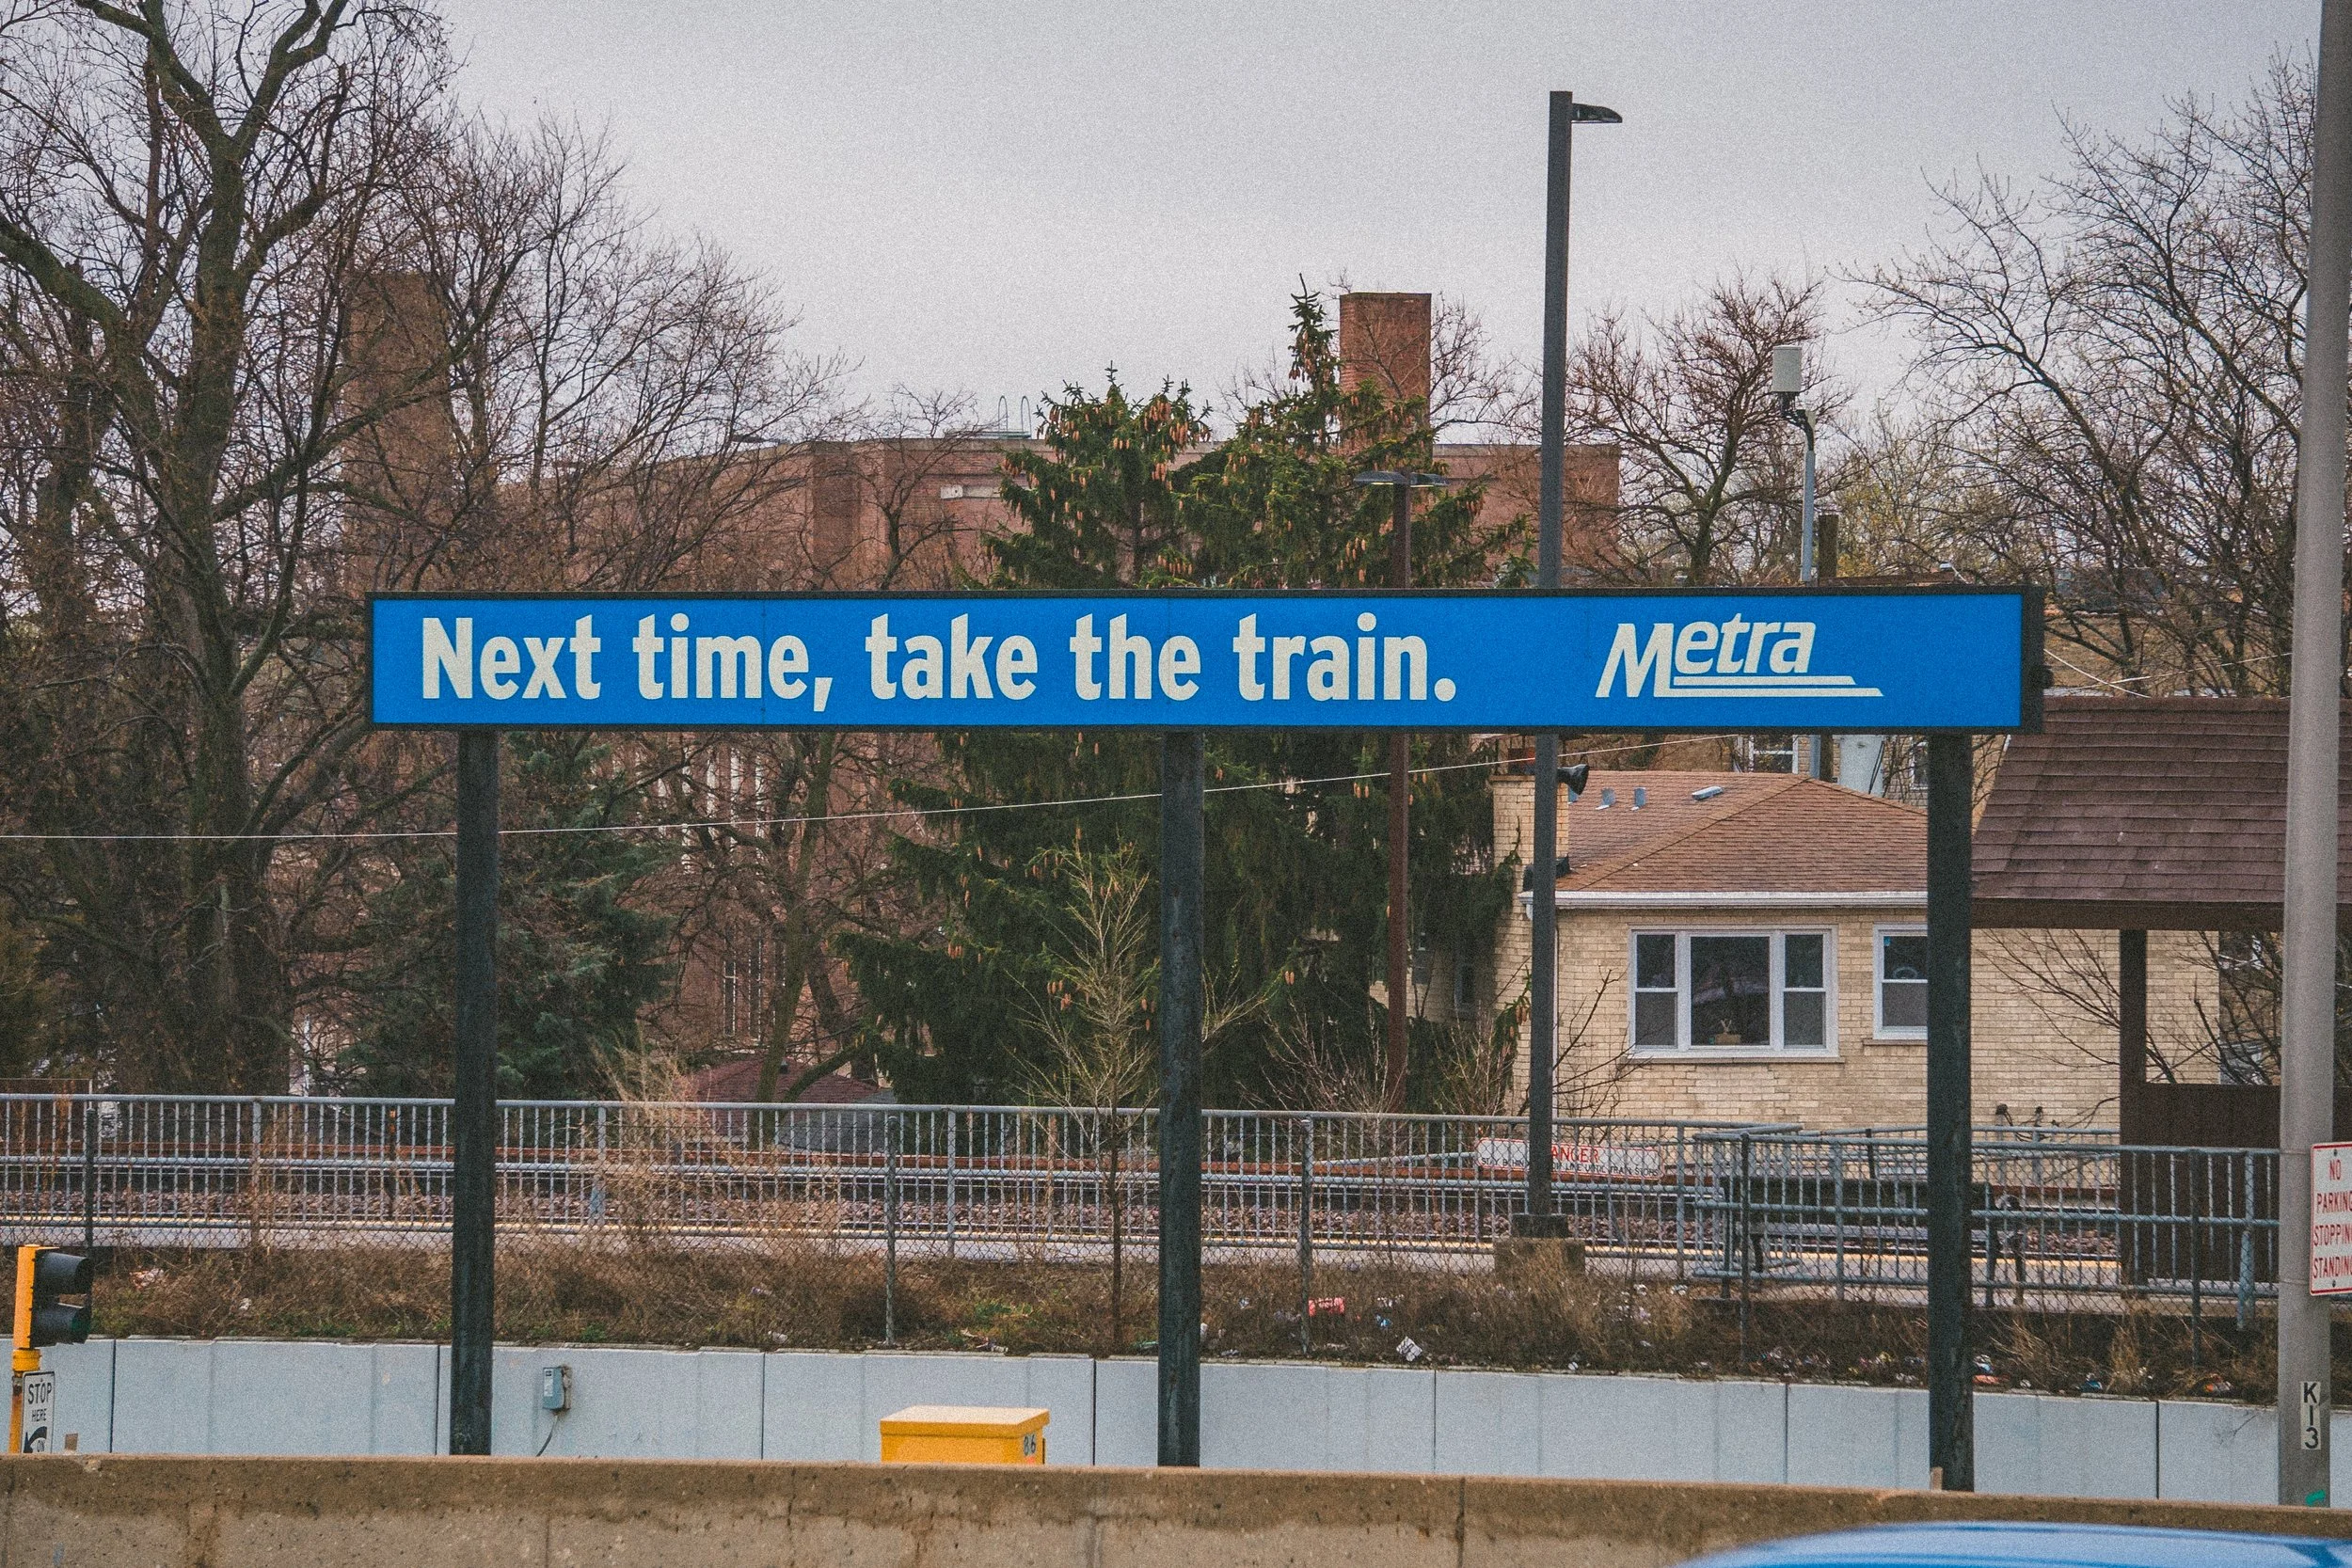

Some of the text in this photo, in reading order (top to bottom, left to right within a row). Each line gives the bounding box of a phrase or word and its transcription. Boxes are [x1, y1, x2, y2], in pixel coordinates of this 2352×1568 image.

[422, 612, 1456, 712] Next time, take the train.
[1596, 612, 1817, 698] Metra
[1549, 1144, 1599, 1164] ANGER
[2329, 1159, 2342, 1181] NO
[28, 1383, 52, 1404] STOP
[31, 1408, 48, 1422] HERE
